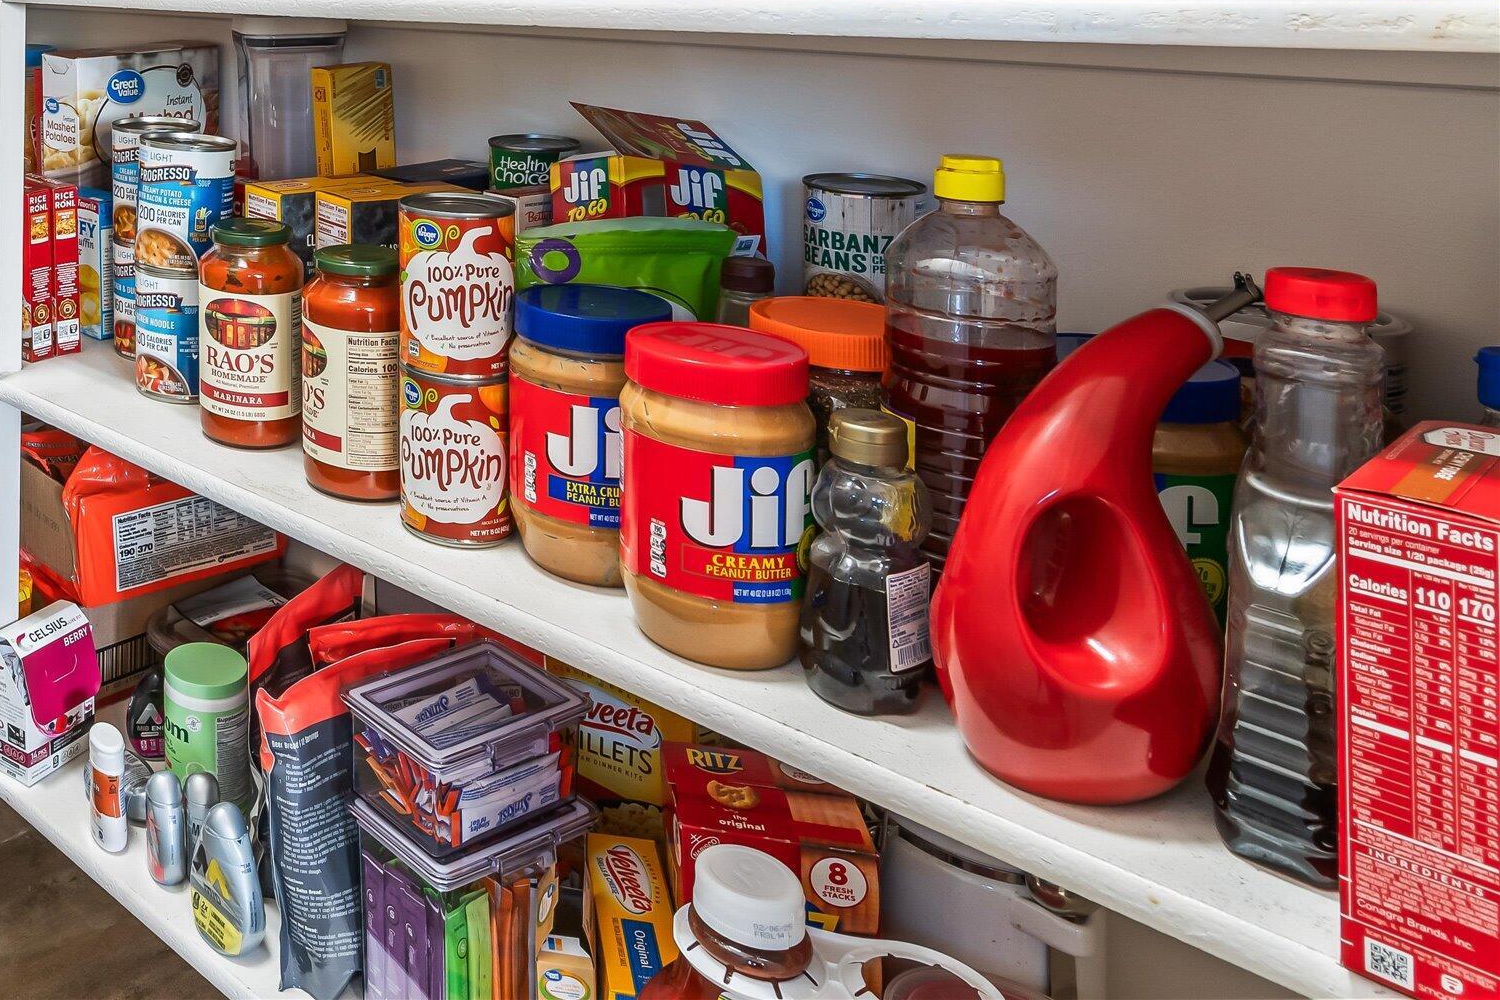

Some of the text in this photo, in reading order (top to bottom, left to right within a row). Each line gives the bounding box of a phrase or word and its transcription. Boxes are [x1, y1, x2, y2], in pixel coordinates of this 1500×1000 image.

[111, 78, 140, 93] Great
[47, 120, 77, 135] Mashed
[45, 131, 77, 146] Potatoes
[150, 152, 174, 164] LIGHT
[500, 155, 550, 175] Healthy
[140, 167, 192, 182] PROGRESSO
[495, 166, 549, 187] Choice
[563, 168, 607, 204] Jif
[669, 167, 722, 209] Jif
[169, 197, 192, 208] CHEESE
[140, 206, 186, 222] 200 CALORIES
[805, 243, 867, 273] BEANS
[427, 263, 500, 283] 100% Pure
[408, 277, 514, 331] Pumpkin
[150, 317, 176, 331] NOODLE
[205, 344, 275, 376] RAO'S
[348, 364, 398, 374] Calories 100
[211, 368, 267, 384] HOMEMADE
[213, 389, 263, 406] MARINARA
[411, 425, 481, 447] 100% Pure
[401, 438, 501, 492] Pumpkin
[566, 482, 597, 497] EXTRA
[679, 459, 816, 548] Jif
[1348, 502, 1494, 551] Nutrition Facts
[1360, 530, 1440, 554] servings container
[712, 553, 785, 570] CREAMY
[1349, 537, 1467, 573] Serving size package
[705, 564, 792, 580] PEANUT BUTTER
[1349, 574, 1496, 620] Calories 110 170
[29, 616, 67, 643] CELSIUS
[63, 627, 88, 647] BERRY
[685, 748, 743, 771] RITZ
[718, 818, 766, 832] original
[606, 847, 652, 914] Velveeta
[828, 862, 848, 885] 8
[1368, 846, 1486, 898] INGREDIENTS
[822, 890, 856, 902] STACKS
[824, 884, 854, 895] FRESH
[1357, 899, 1405, 928] Conagra
[632, 929, 653, 970] Original
